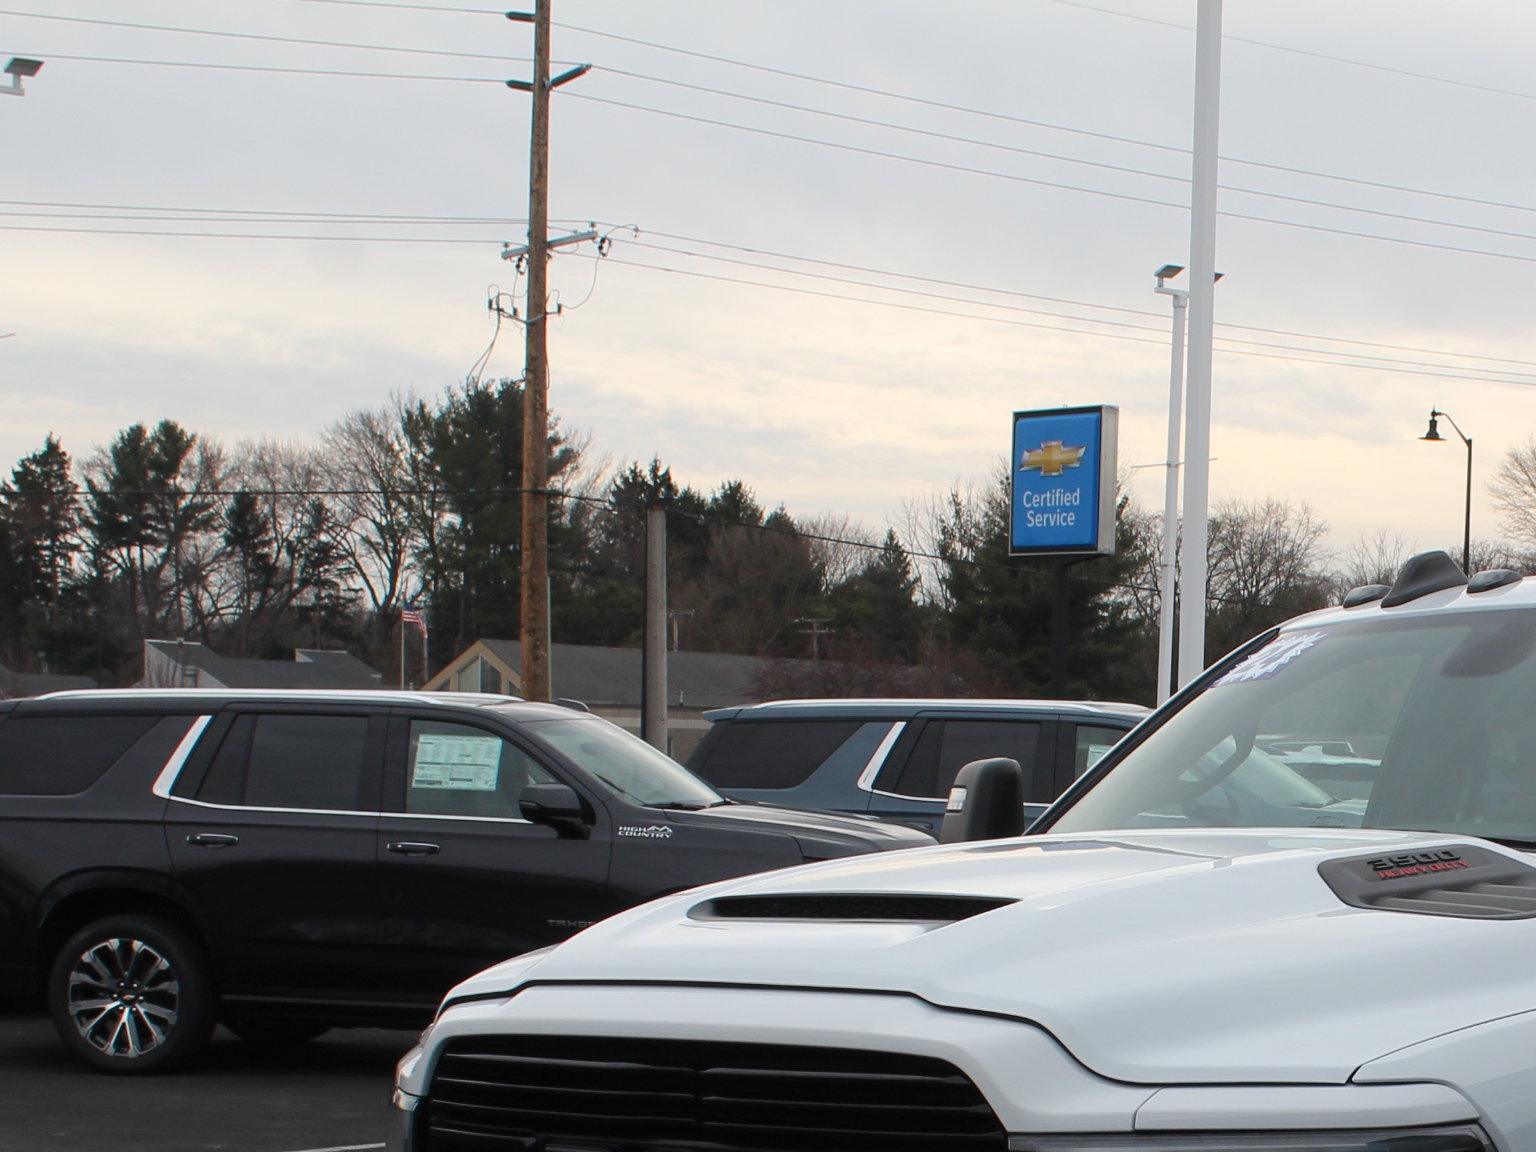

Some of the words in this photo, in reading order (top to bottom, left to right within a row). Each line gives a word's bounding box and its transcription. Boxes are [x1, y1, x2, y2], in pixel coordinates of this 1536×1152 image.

[1023, 488, 1081, 507] Certified
[1026, 509, 1075, 528] Service
[617, 830, 671, 839] COUNTRY
[1377, 865, 1429, 879] HEAVY
[1430, 861, 1469, 872] DUTY
